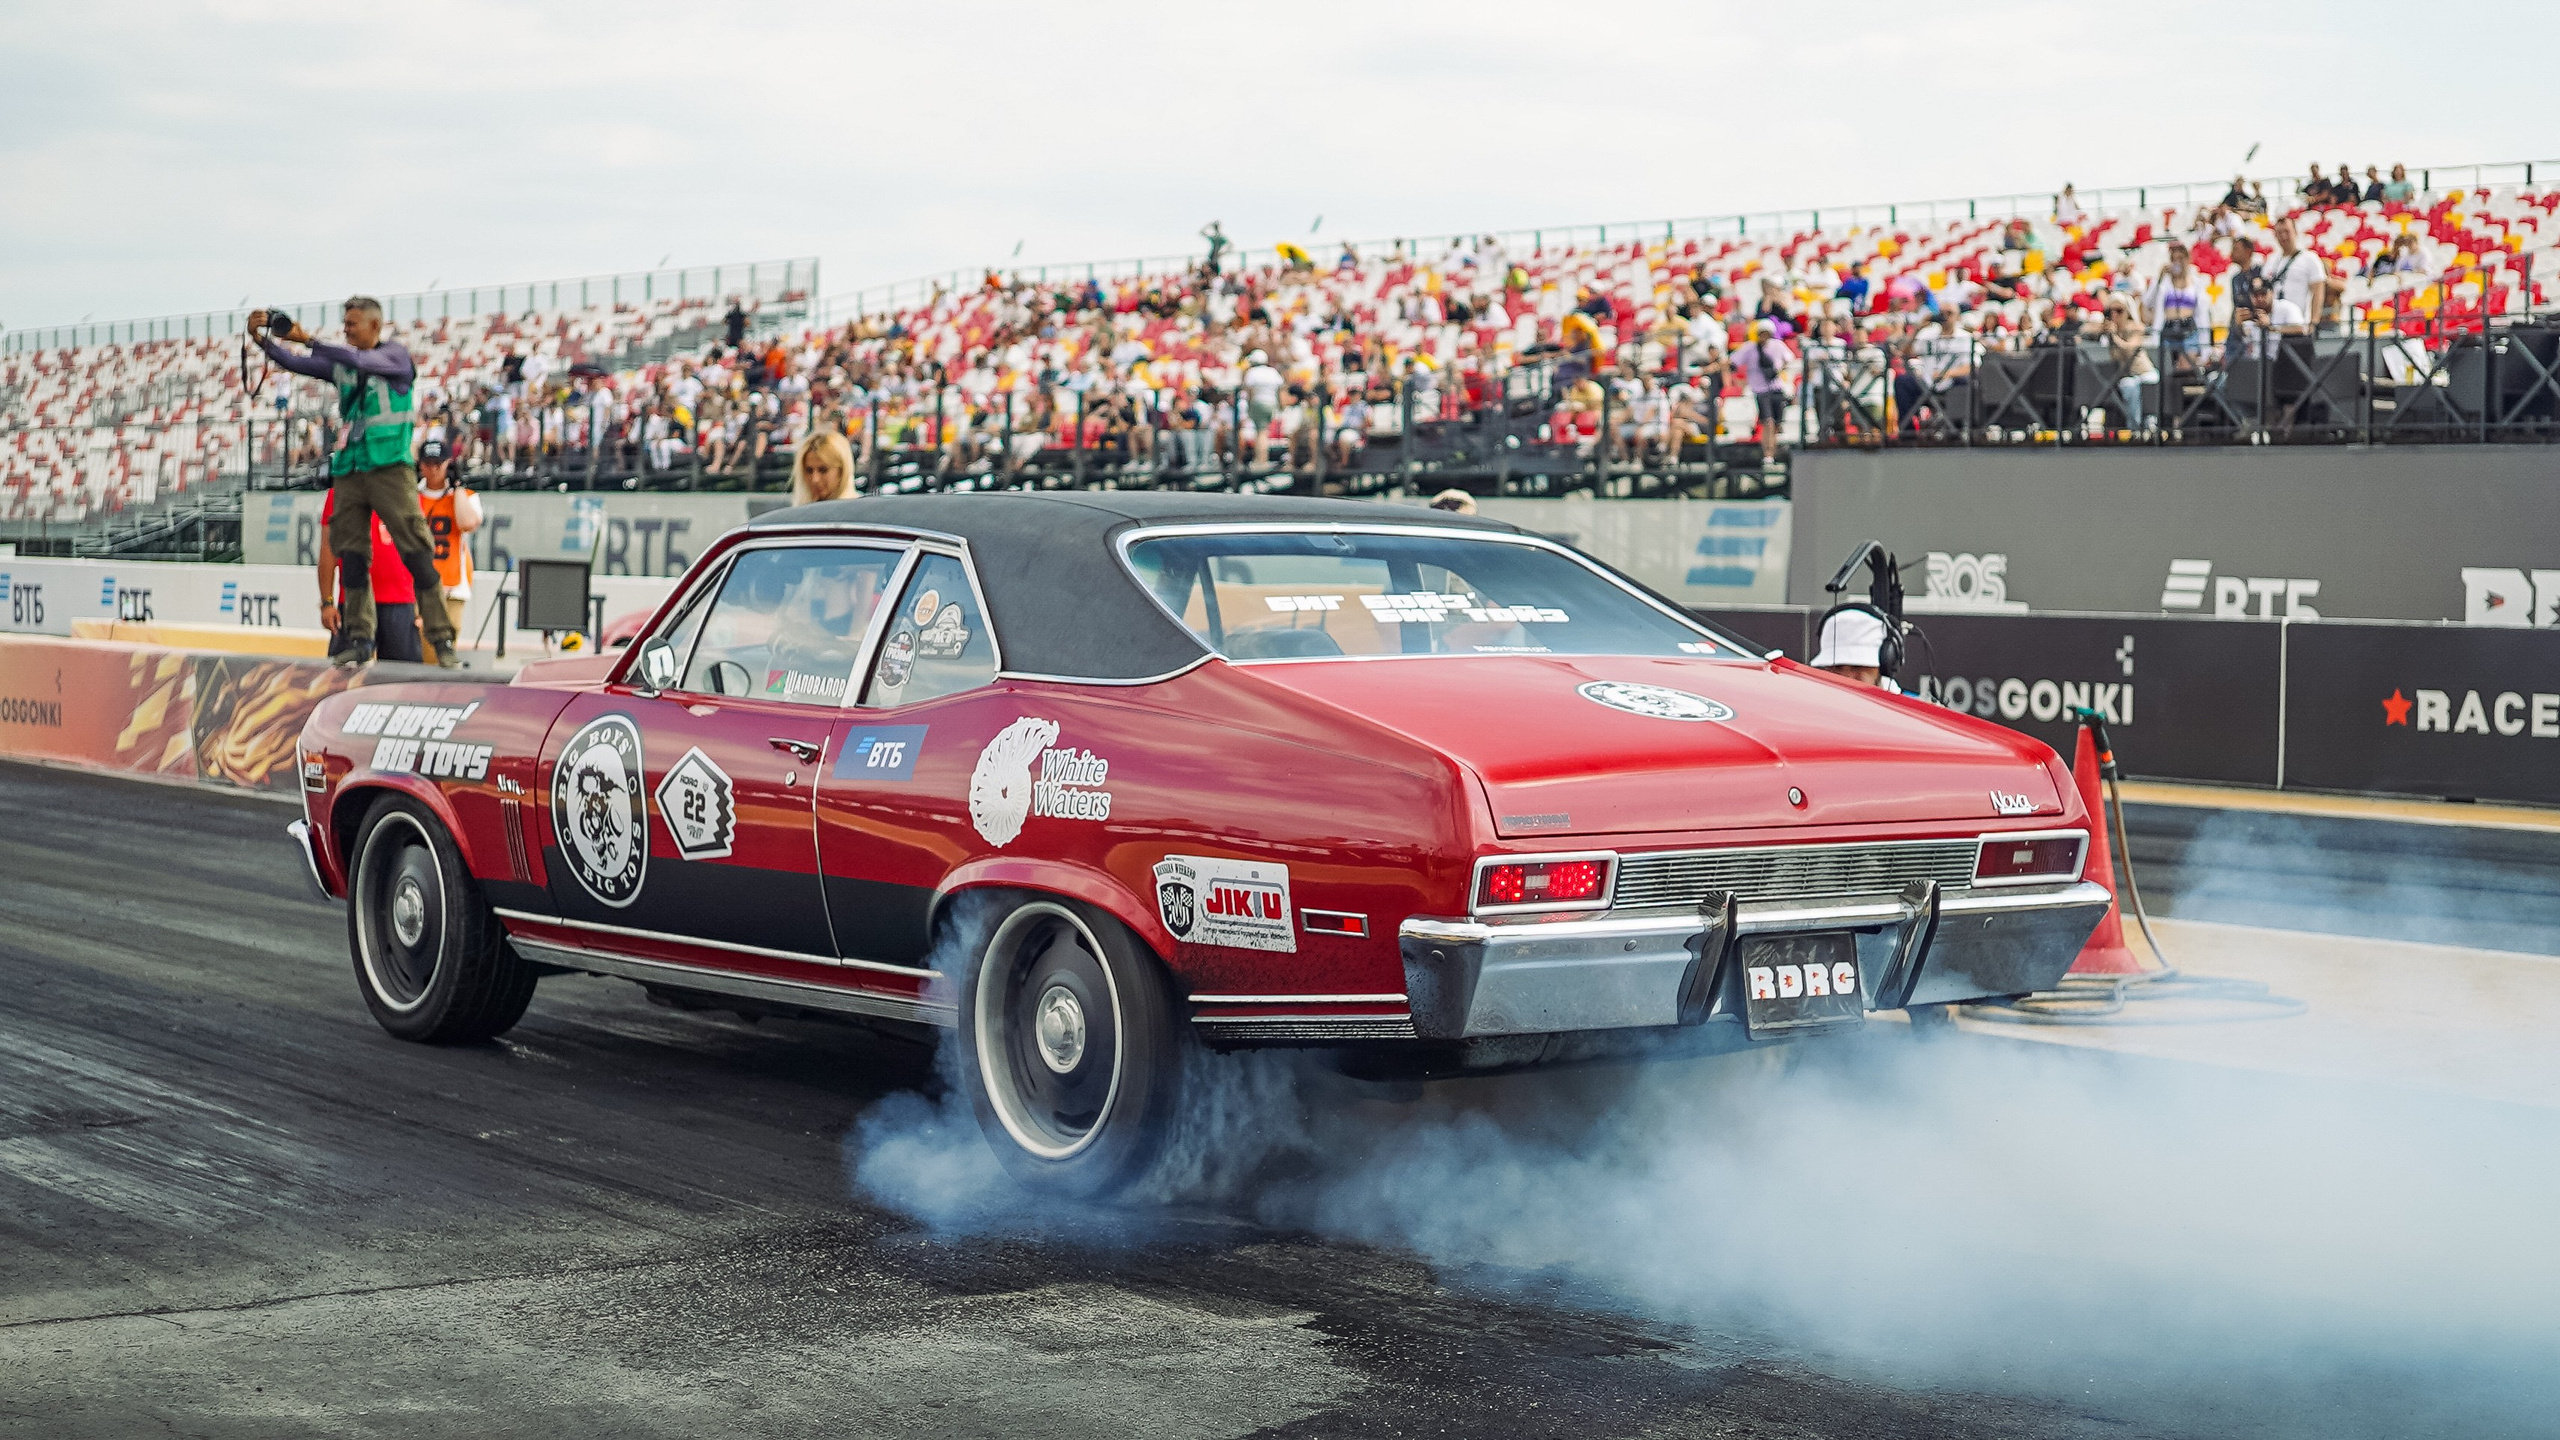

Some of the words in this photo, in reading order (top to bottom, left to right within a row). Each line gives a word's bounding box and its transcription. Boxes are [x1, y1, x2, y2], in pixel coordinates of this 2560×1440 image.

[1926, 551, 2007, 601] ROS
[13, 584, 44, 624] ВТБ
[784, 670, 847, 698] ШАПОВАЛОВ
[0, 697, 61, 728] OSGONKI
[342, 703, 394, 734] BIG
[382, 701, 481, 740] BOYS'
[2416, 688, 2560, 738] RACE
[370, 737, 421, 772] BIG
[420, 740, 493, 780] TOYS
[557, 748, 579, 802] BIG
[587, 727, 633, 756] BOYS'
[866, 742, 906, 768] ВТБ
[1043, 750, 1106, 784] White
[683, 788, 706, 825] 22
[1035, 782, 1110, 818] Waters
[1989, 789, 2040, 812] Nova
[582, 862, 616, 894] BIG
[620, 821, 642, 890] TOYS
[1748, 961, 1856, 1000] RDRC
